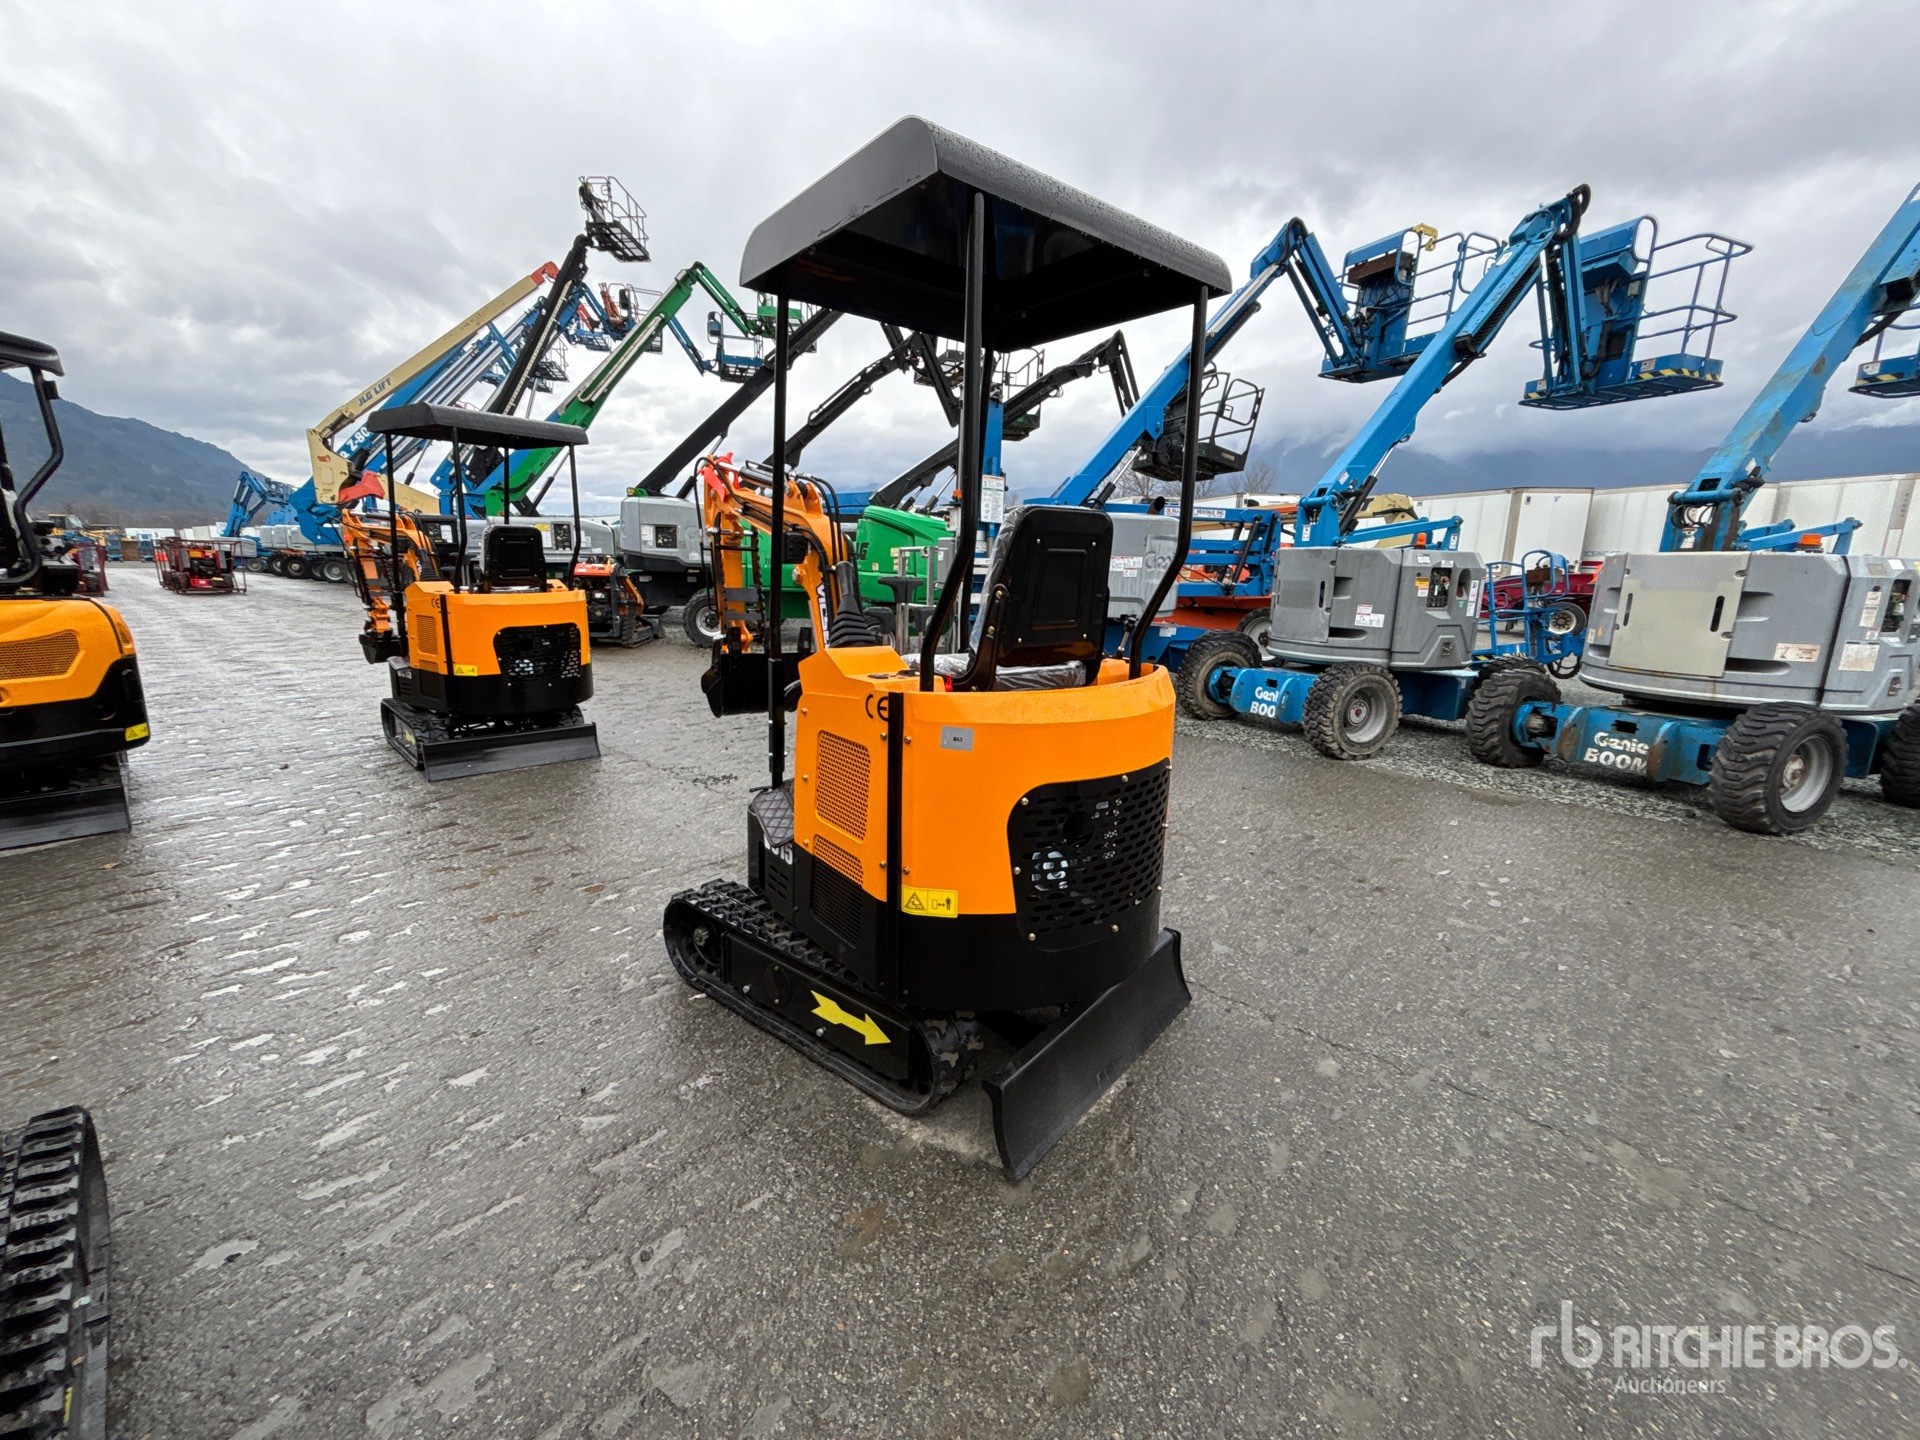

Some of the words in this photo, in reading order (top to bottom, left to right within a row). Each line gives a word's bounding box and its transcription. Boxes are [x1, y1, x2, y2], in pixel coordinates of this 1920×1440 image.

[358, 391, 374, 407] JLG
[373, 377, 392, 395] LIFT
[346, 426, 370, 452] Z-80
[1254, 686, 1282, 704] Geni
[1249, 700, 1277, 719] BOO
[1594, 731, 1650, 756] Genie
